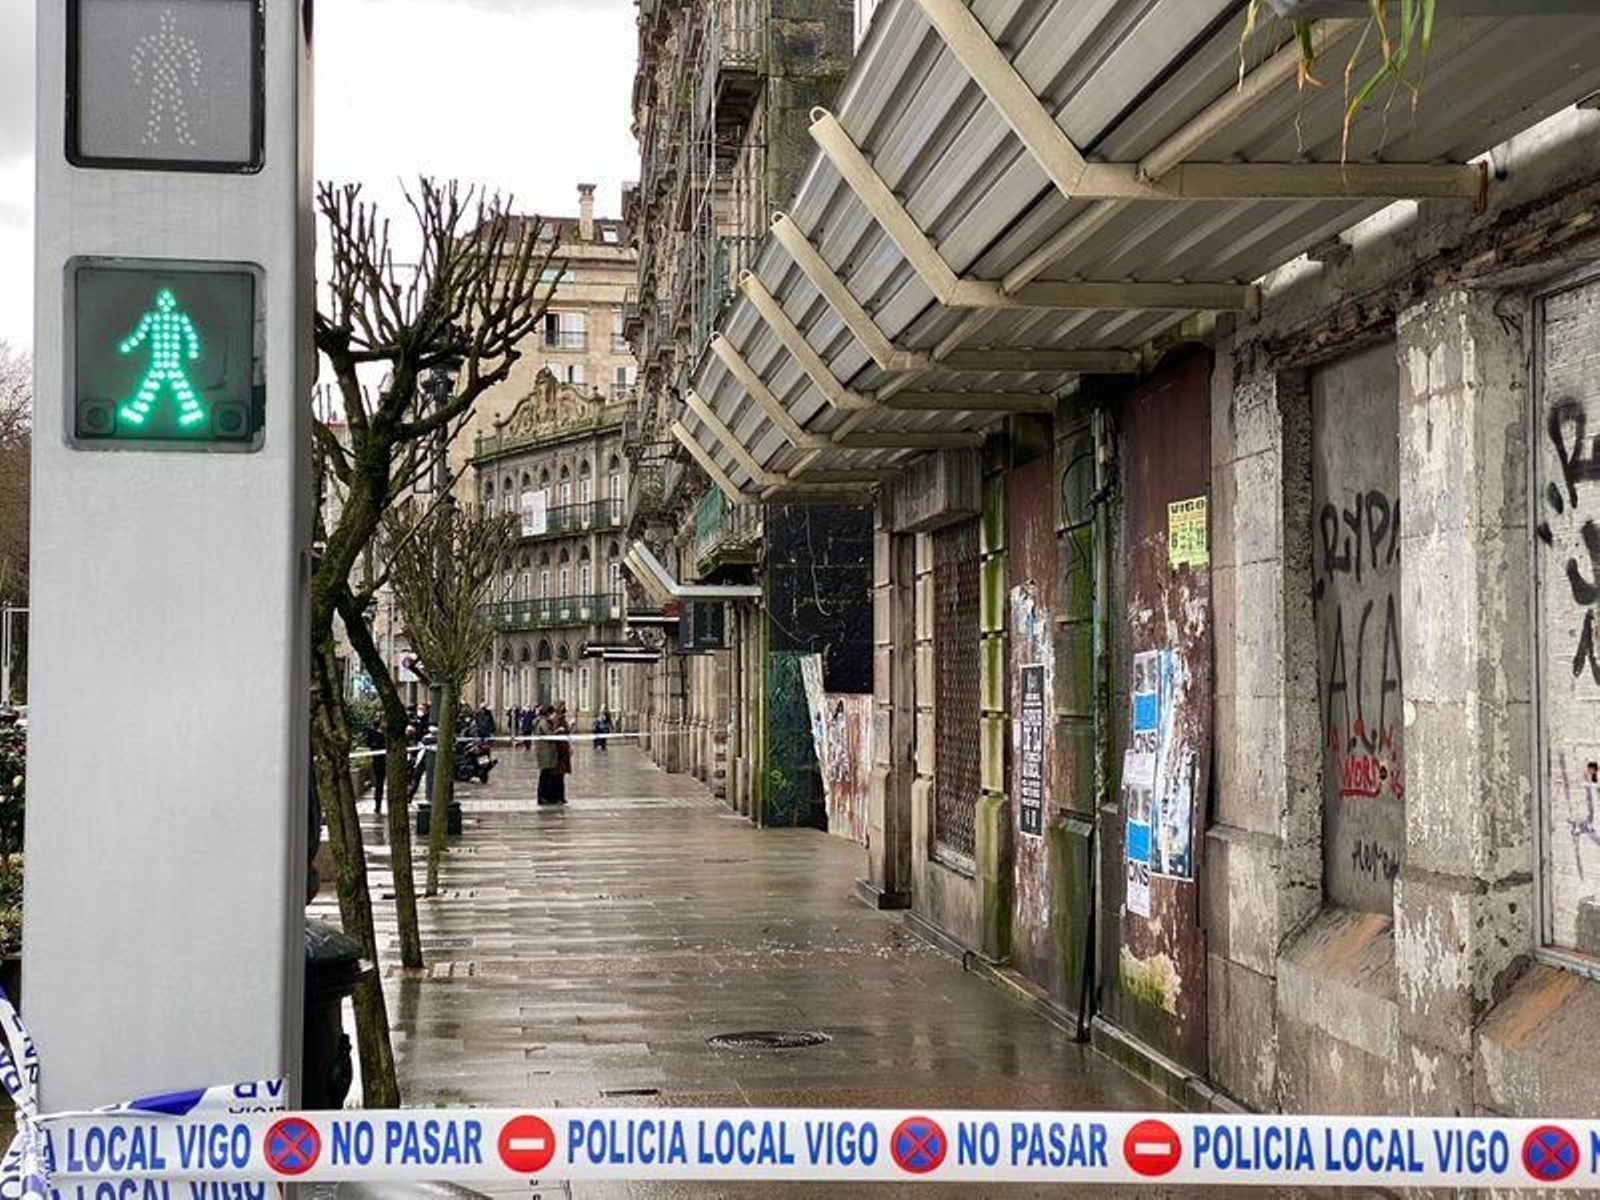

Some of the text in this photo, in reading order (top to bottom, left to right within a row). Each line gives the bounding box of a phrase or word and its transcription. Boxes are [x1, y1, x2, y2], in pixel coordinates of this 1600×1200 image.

[66, 1124, 166, 1172] LOCAL
[175, 1123, 251, 1169] VIGO
[331, 1120, 483, 1166] NO PASAR
[567, 1119, 879, 1166] POLICIA LOCAL VIGO
[957, 1121, 1108, 1167] NO PASAR
[1193, 1124, 1510, 1174] POLICIA LOCAL VIGO
